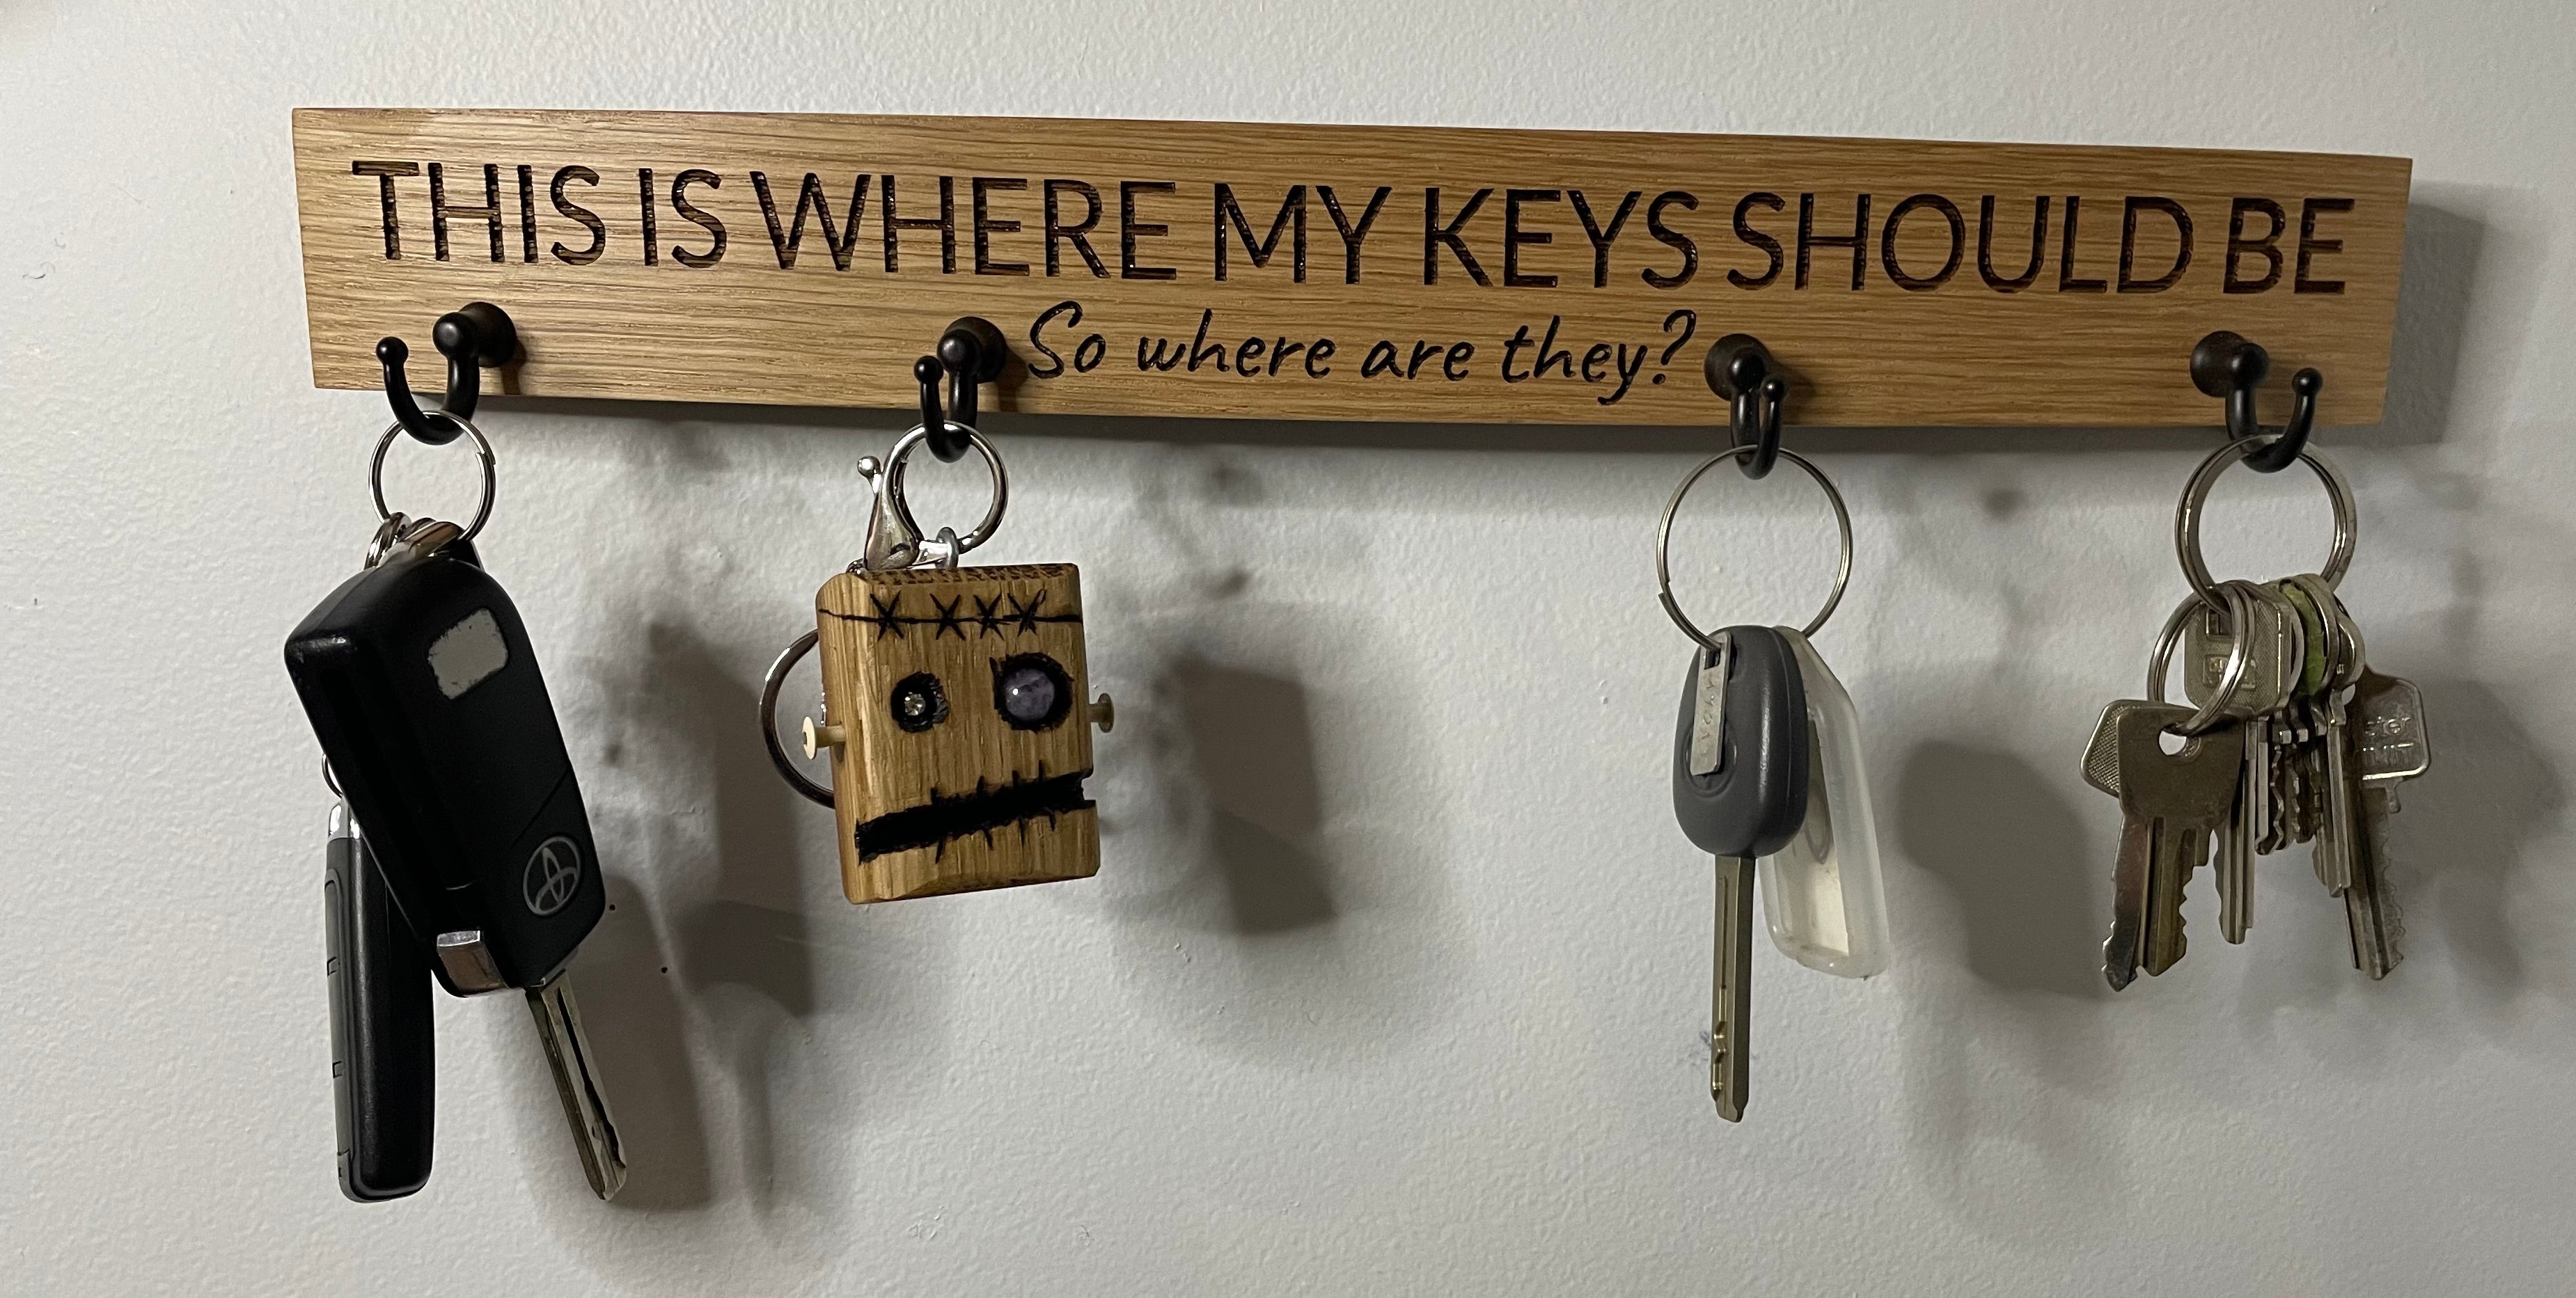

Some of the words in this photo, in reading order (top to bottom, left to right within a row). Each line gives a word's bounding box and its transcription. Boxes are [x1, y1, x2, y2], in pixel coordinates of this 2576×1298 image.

[352, 160, 606, 266] THIS
[638, 167, 728, 269] IS
[749, 171, 1177, 280] WHERE
[1214, 182, 1392, 285] MY
[1424, 187, 1699, 289] KEYS
[1726, 191, 2194, 293] SHOULD
[2222, 197, 2356, 294] BE
[1027, 300, 1107, 379] So
[1137, 308, 1335, 379] where
[1360, 335, 1476, 383] are
[1501, 309, 1697, 406] they?
